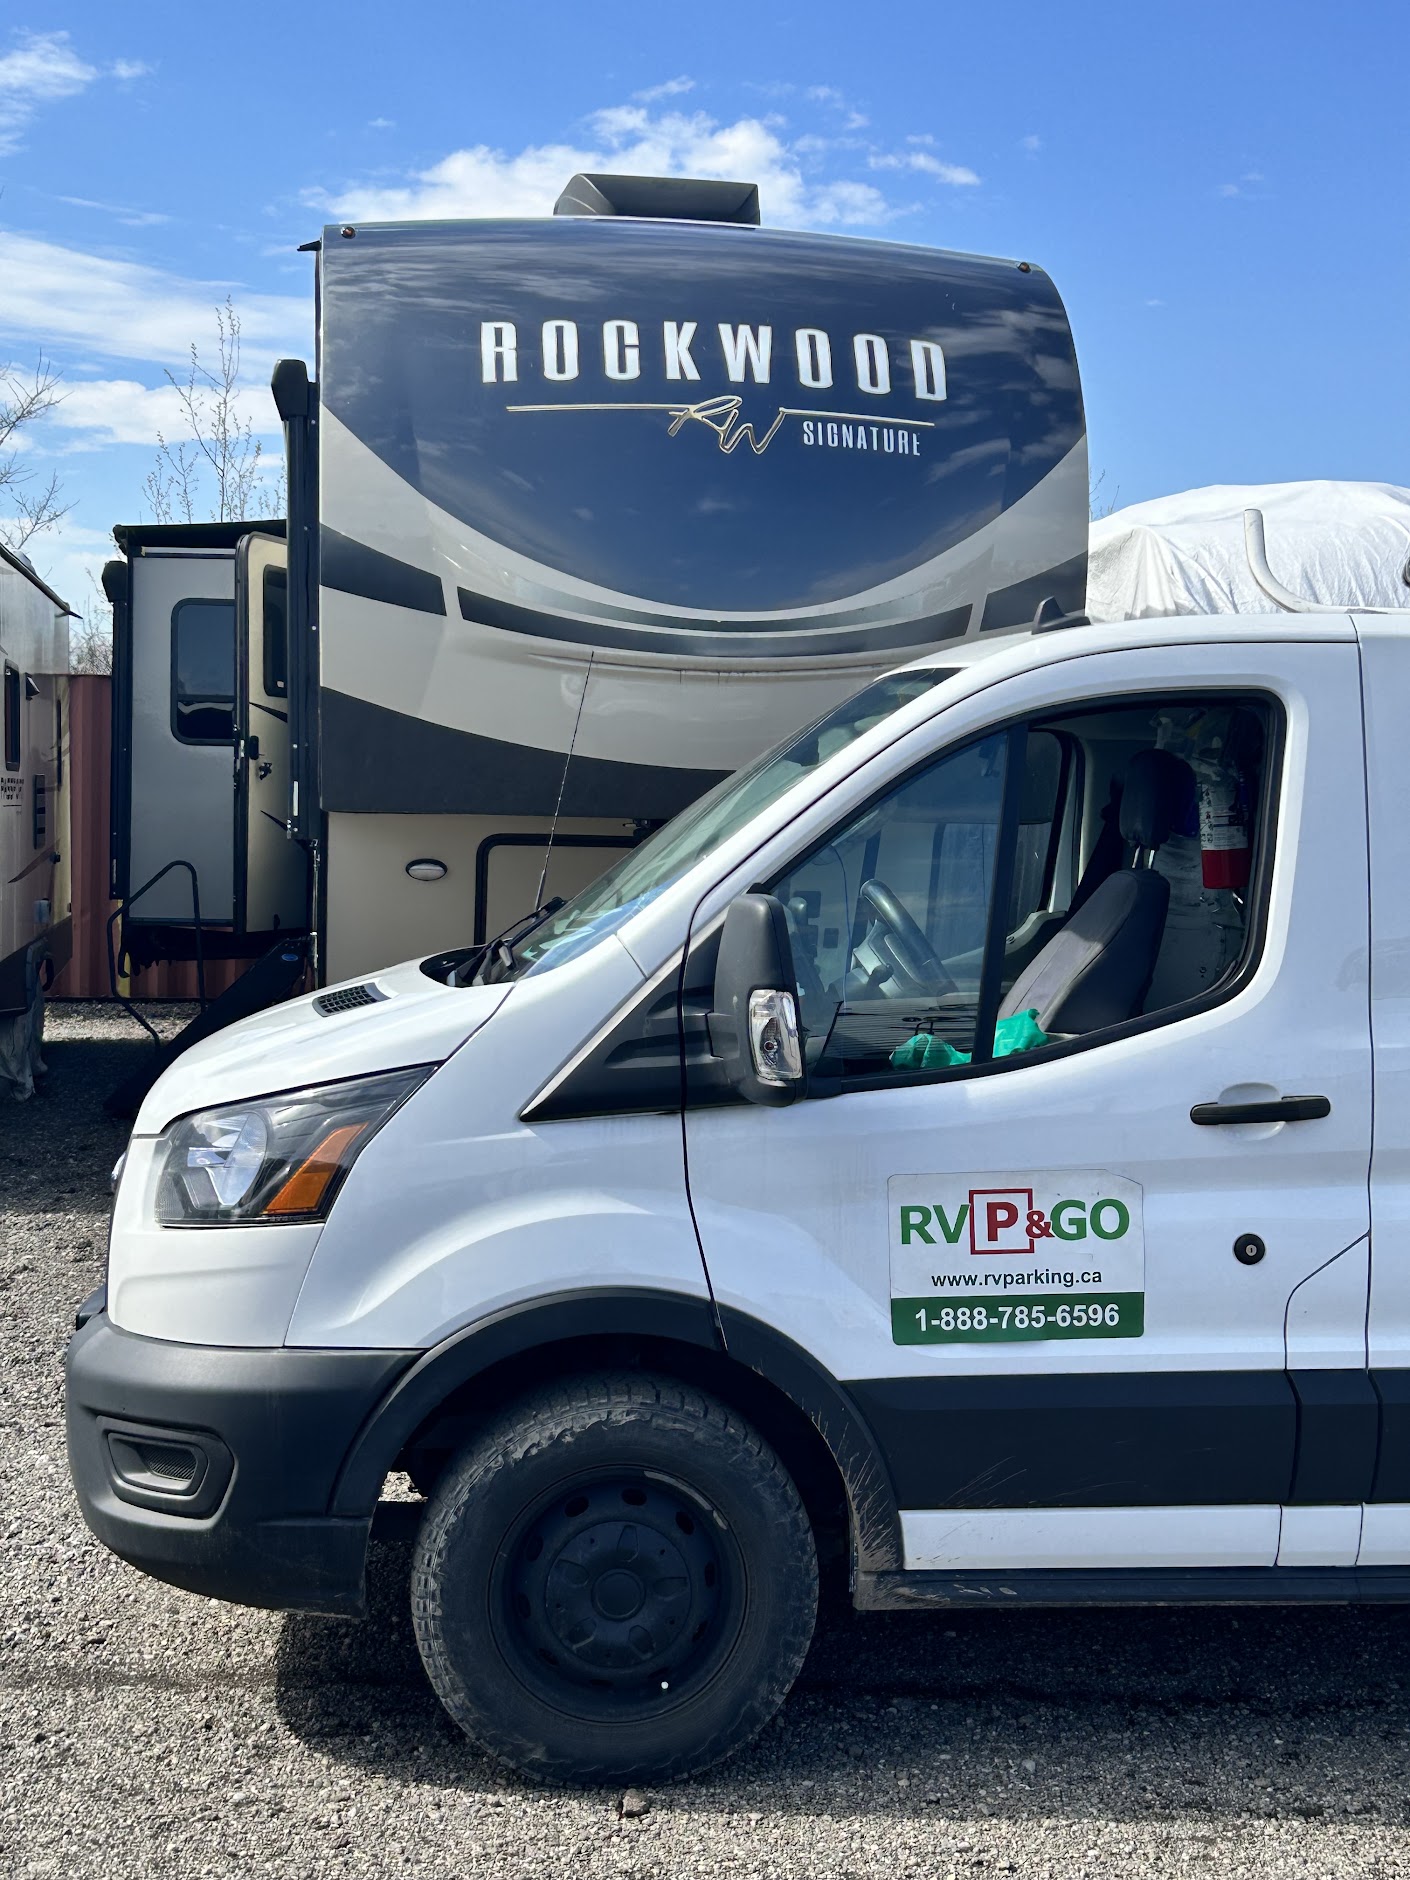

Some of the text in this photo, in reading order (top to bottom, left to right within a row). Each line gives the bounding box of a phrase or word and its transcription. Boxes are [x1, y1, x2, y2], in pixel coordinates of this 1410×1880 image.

[480, 319, 947, 401] ROCKWOOD
[802, 420, 921, 456] SIGNATURE
[900, 1203, 970, 1245] RV
[931, 1268, 1103, 1289] www.rvparking.ca
[915, 1303, 1120, 1332] 1-888-785-6596
